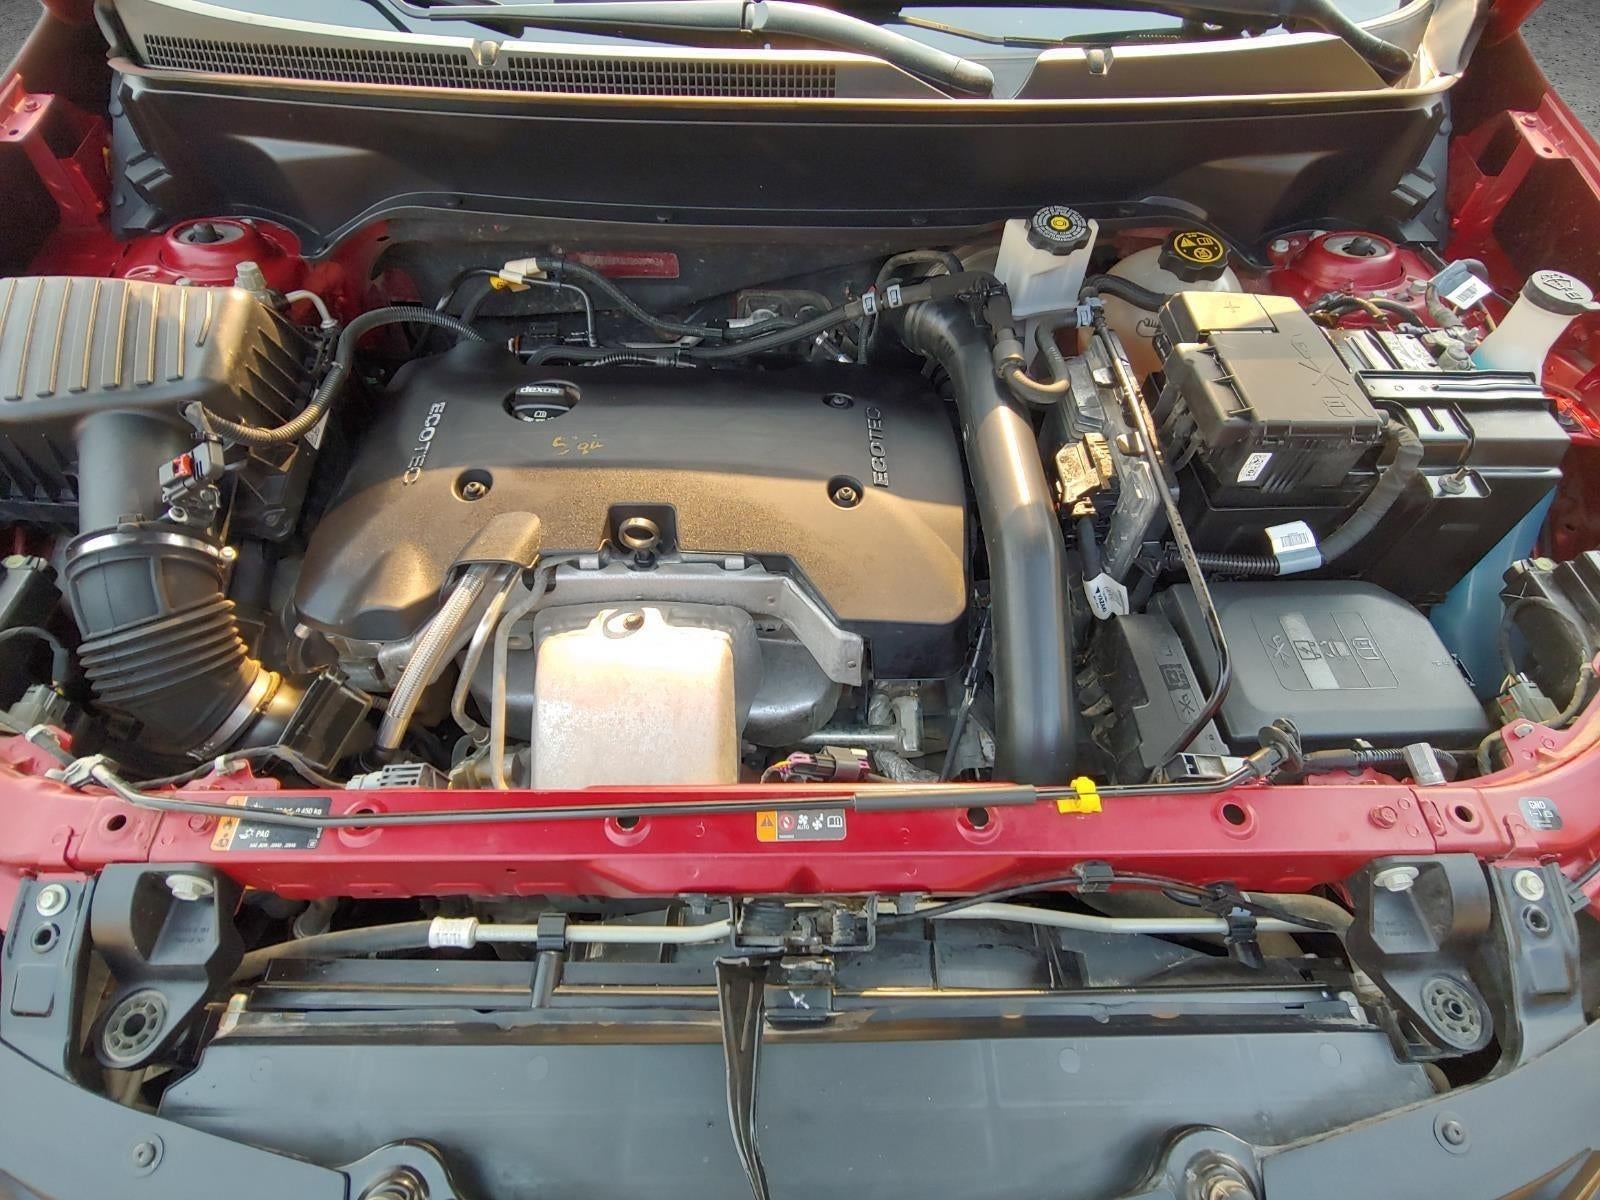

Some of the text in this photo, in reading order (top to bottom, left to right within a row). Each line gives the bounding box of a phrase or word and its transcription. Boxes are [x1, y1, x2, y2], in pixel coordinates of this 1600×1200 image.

[520, 385, 560, 394] dexos
[402, 400, 446, 487] ECOTEC
[865, 407, 889, 487] ECOTEC
[255, 830, 271, 838] PAG
